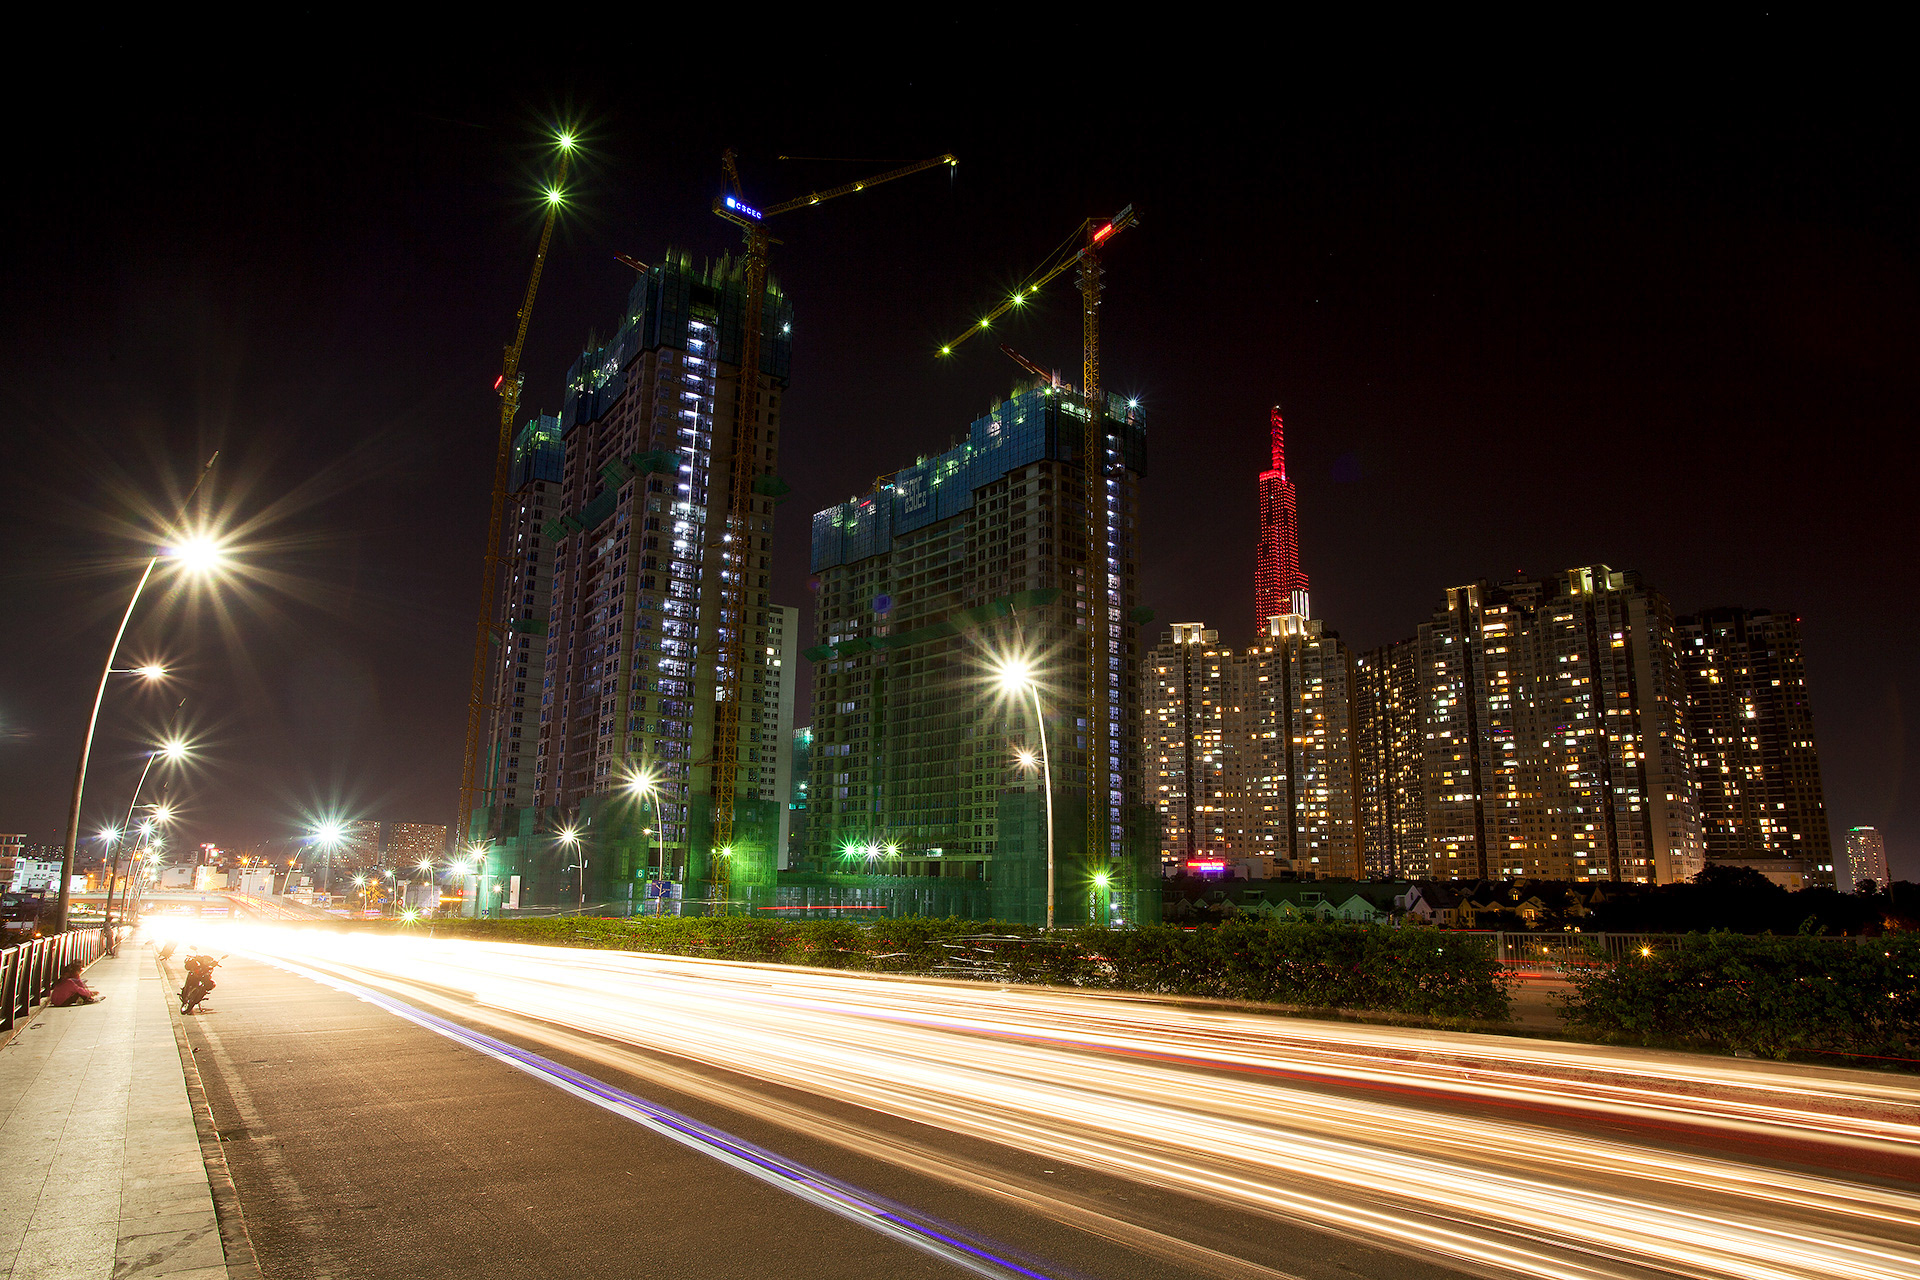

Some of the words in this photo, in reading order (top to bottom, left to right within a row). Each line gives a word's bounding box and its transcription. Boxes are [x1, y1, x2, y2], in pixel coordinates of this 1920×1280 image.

[735, 202, 762, 219] CSCEC
[664, 487, 671, 495] 24
[658, 563, 666, 571] 20
[649, 683, 657, 691] 14
[646, 724, 655, 733] 12
